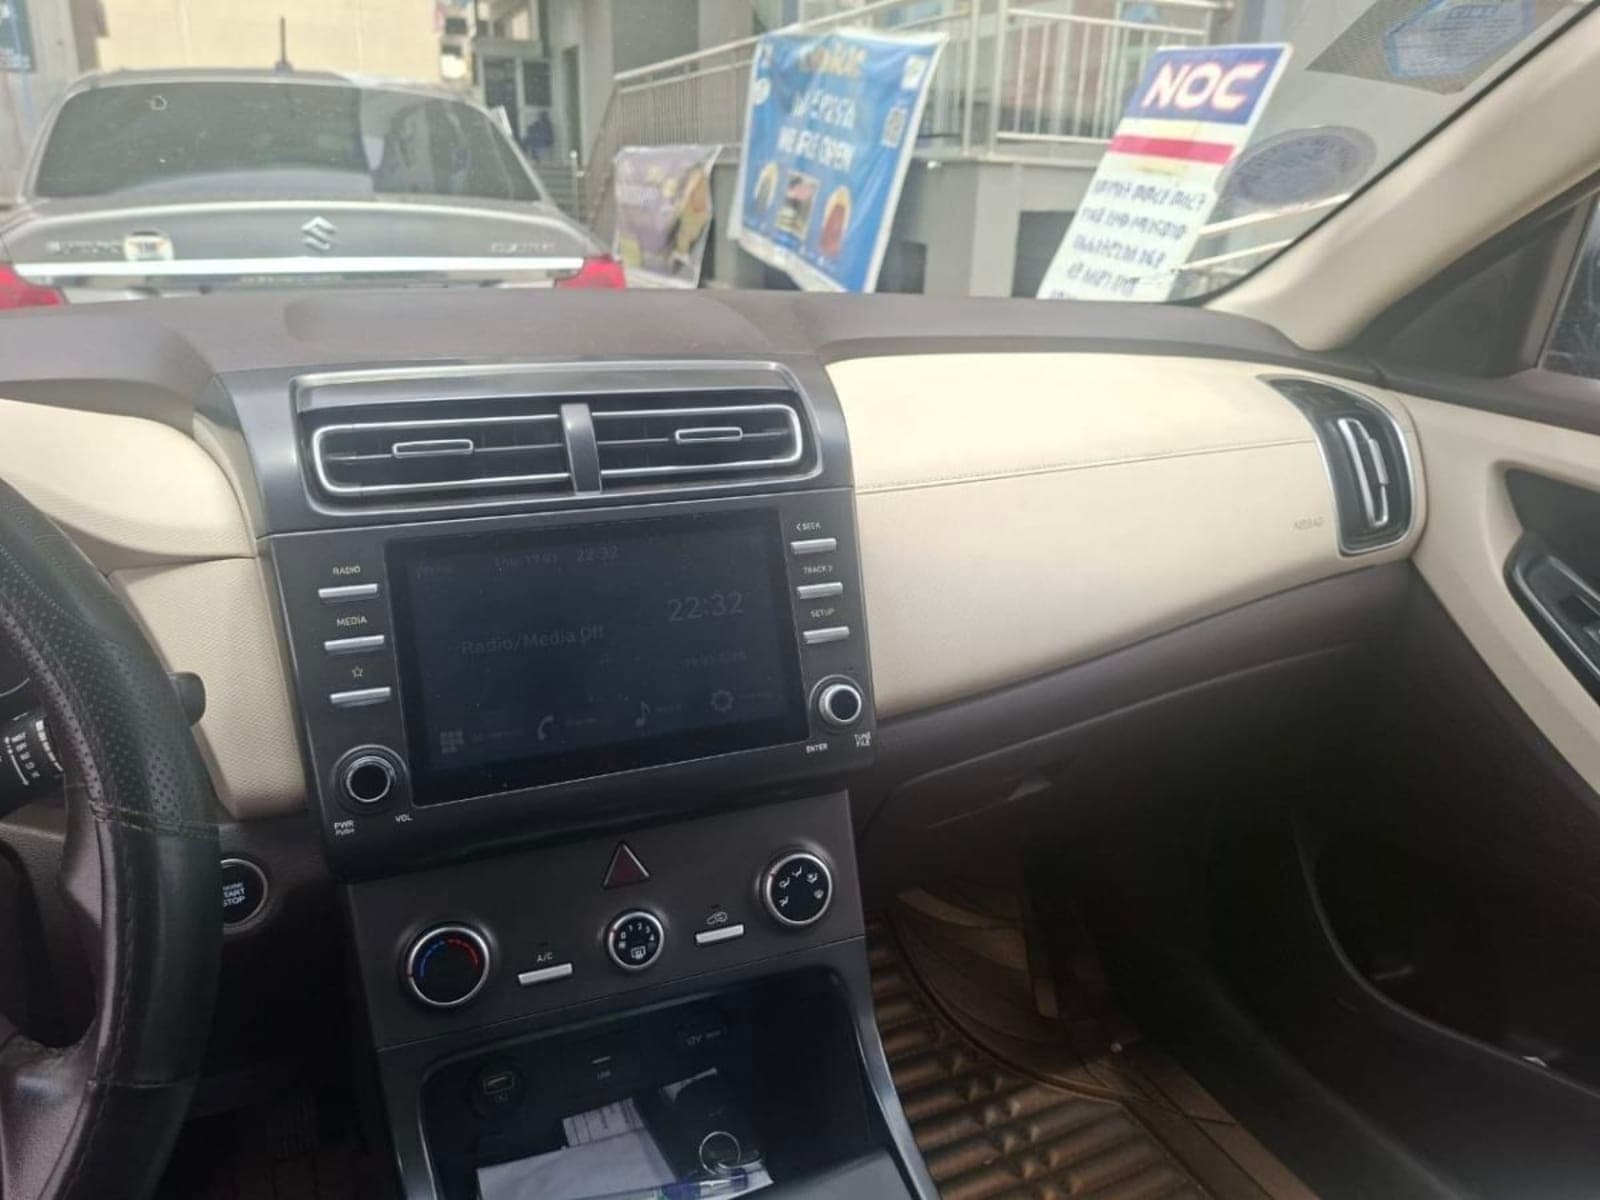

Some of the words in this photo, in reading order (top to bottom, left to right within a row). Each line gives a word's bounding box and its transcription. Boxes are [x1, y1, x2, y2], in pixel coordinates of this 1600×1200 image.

[1141, 61, 1266, 110] NOC
[332, 565, 361, 576] RADIO
[665, 590, 745, 623] 22:32
[810, 607, 835, 618] SETUP
[336, 615, 369, 627] MEDIA
[461, 628, 577, 655] Radio/Media
[805, 742, 829, 754] ENTER
[394, 813, 413, 823] VOL
[536, 952, 553, 964] A/C
